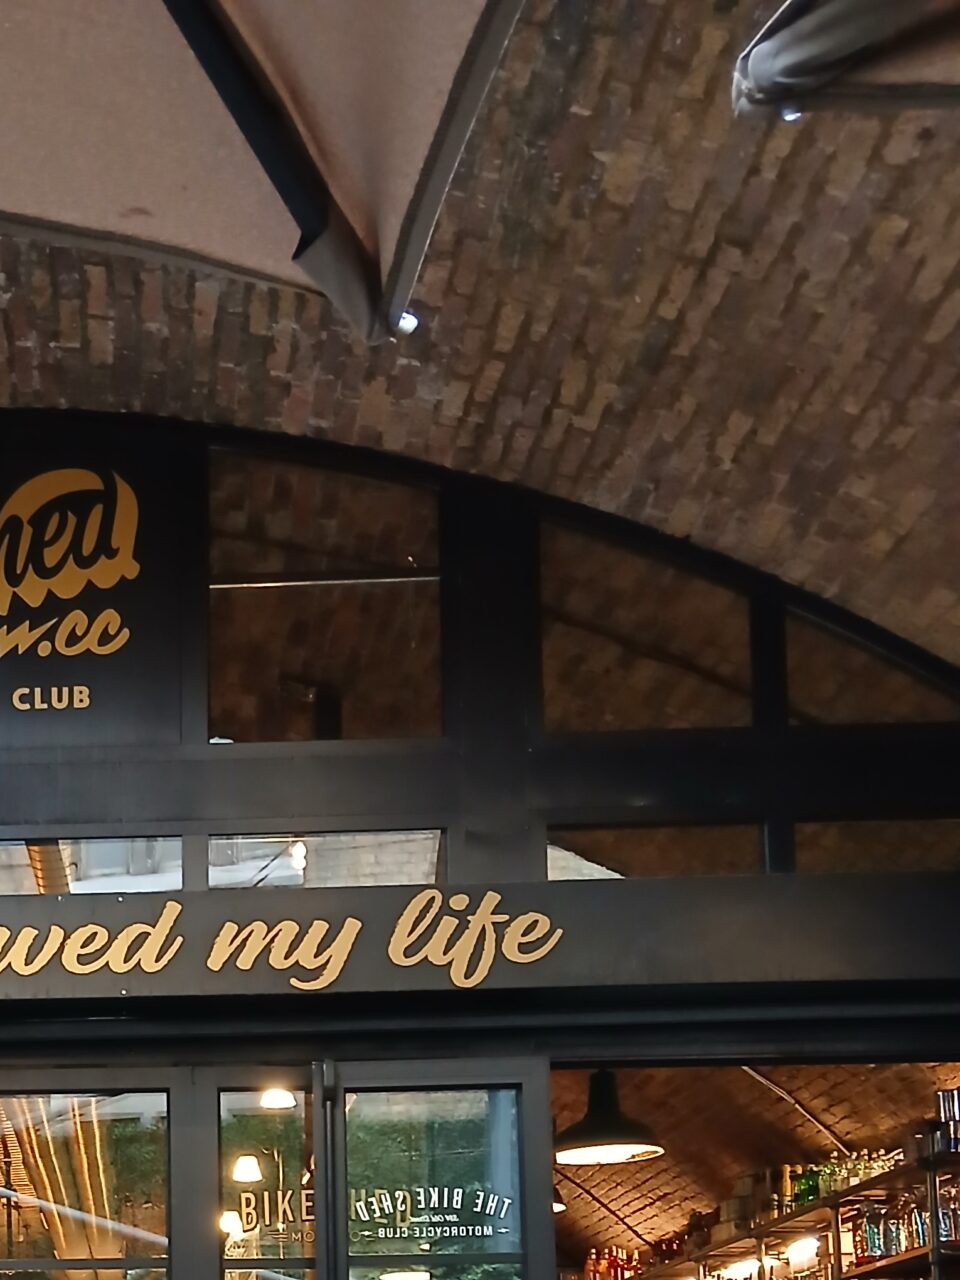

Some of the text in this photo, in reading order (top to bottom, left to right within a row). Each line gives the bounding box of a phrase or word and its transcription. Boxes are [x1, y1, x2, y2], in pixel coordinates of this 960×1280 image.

[12, 685, 91, 710] CLUB
[206, 916, 362, 991] my
[387, 888, 563, 988] life
[240, 1189, 316, 1233] BIKE
